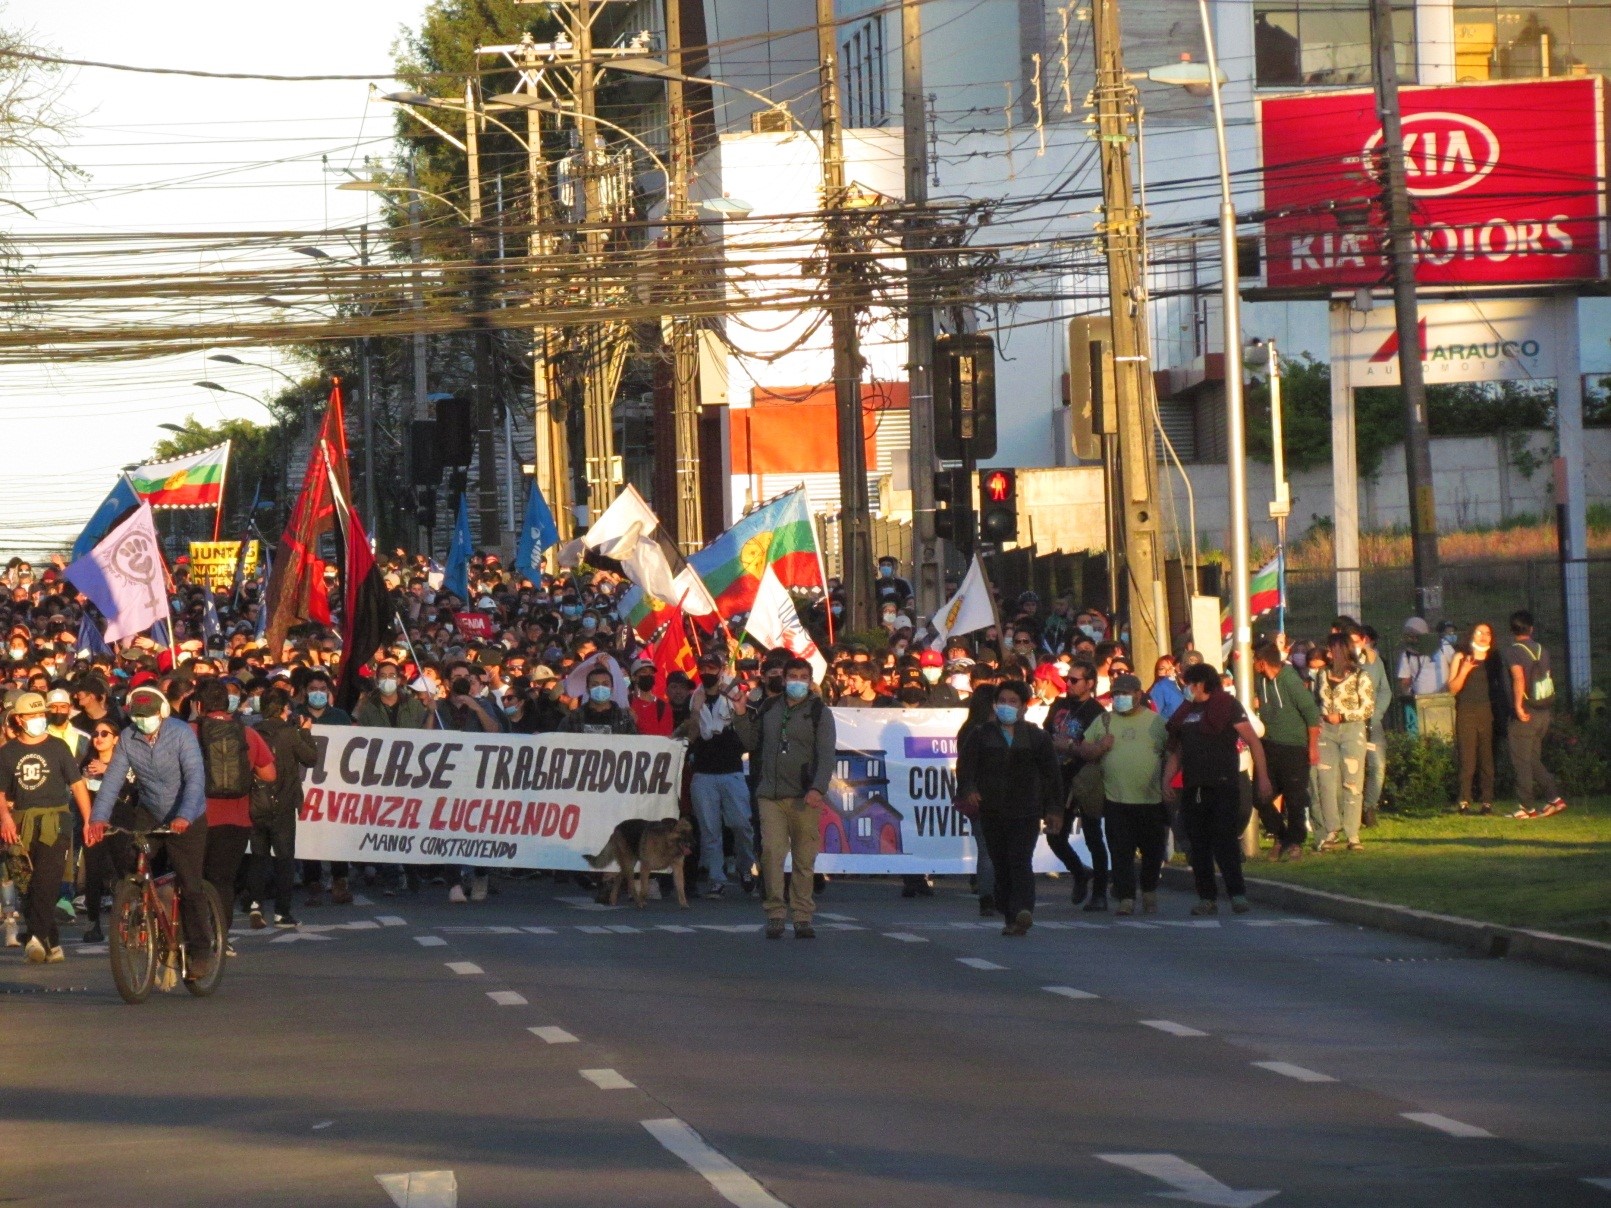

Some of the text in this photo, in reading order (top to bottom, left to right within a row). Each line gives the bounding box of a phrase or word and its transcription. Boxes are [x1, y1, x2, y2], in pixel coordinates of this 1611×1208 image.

[1402, 130, 1477, 176] KIA
[1291, 233, 1367, 271] KIA
[1431, 339, 1540, 361] ARAUCO
[1367, 359, 1539, 375] AUOMOTRIZ
[193, 547, 256, 559] JUNTS
[340, 736, 463, 789] CLASE
[298, 788, 581, 840] AVANZA LUCHANDO
[913, 805, 972, 837] VIVIE
[359, 832, 517, 859] MANOS CONSTRUYENDO
